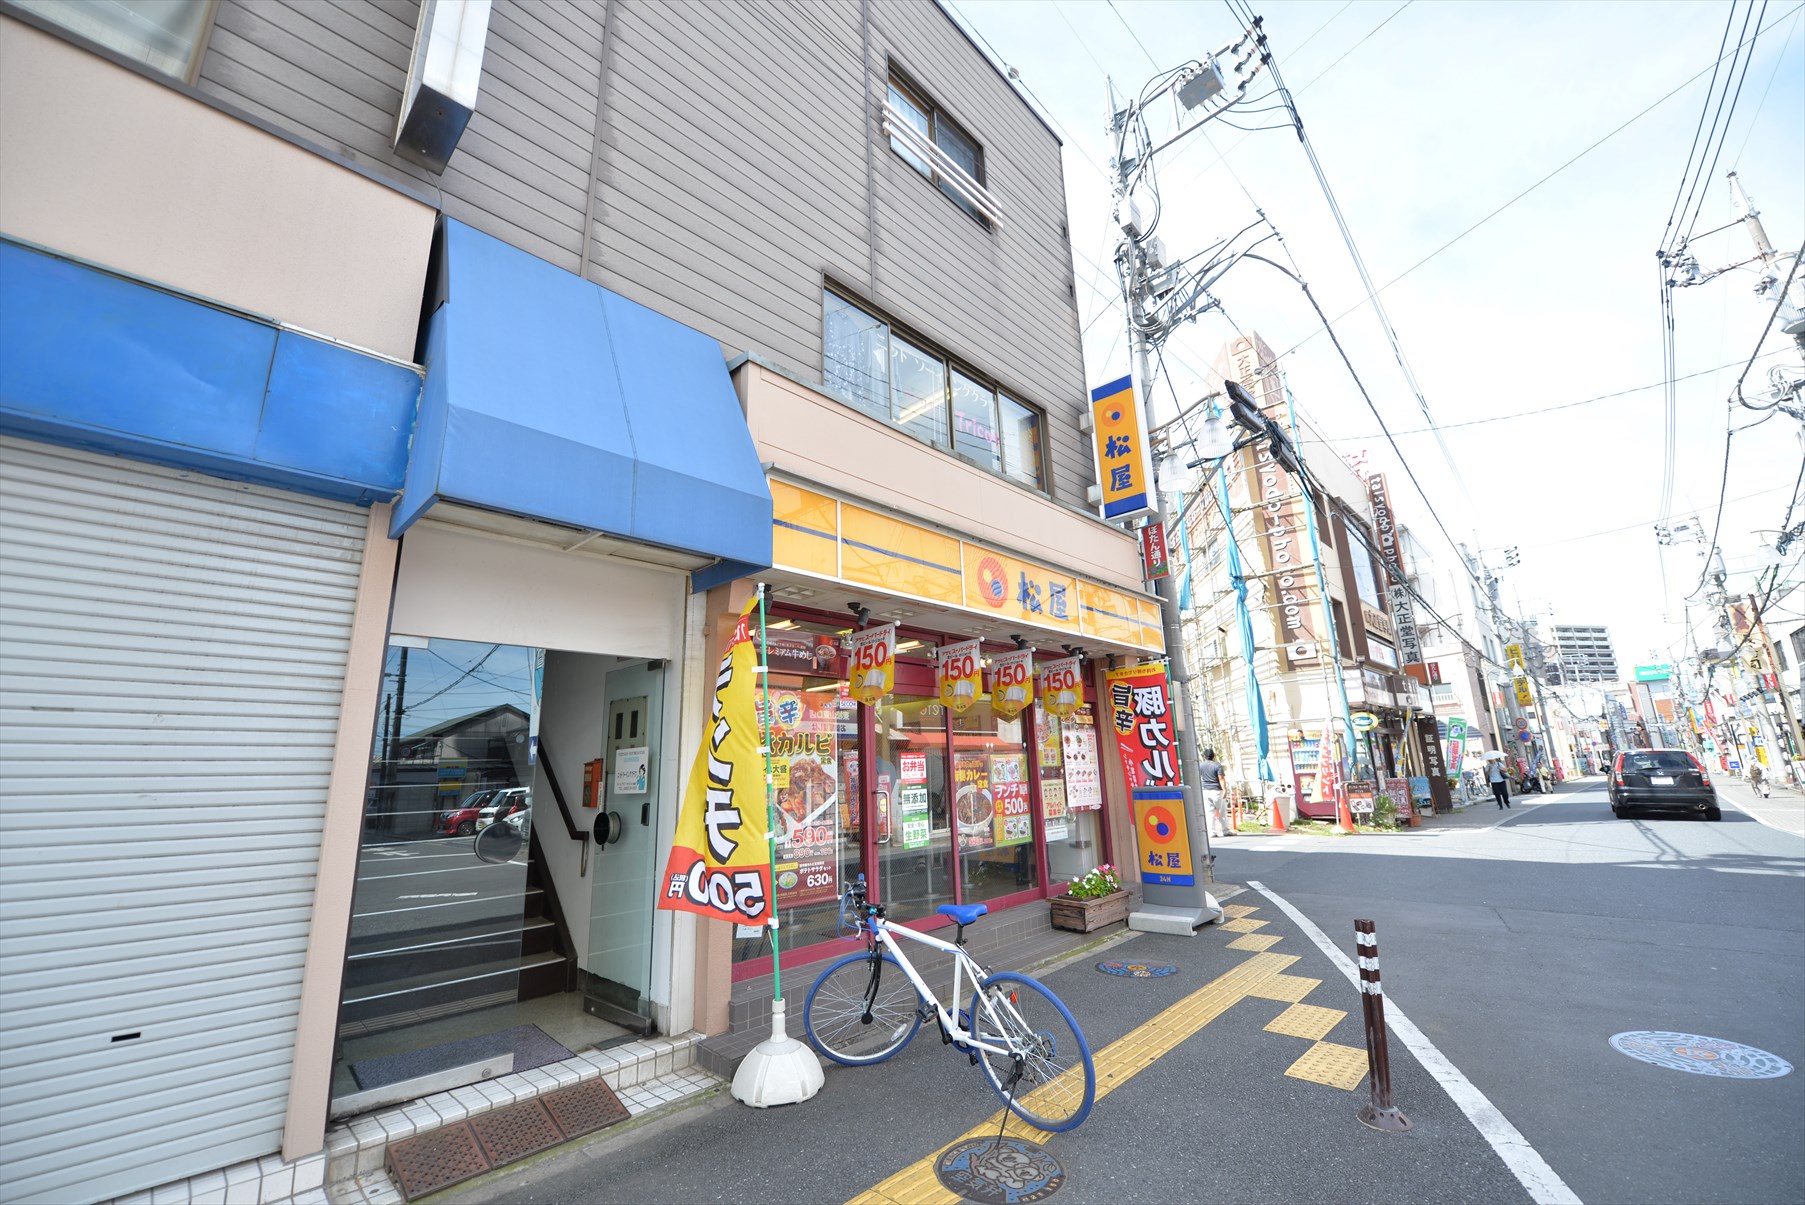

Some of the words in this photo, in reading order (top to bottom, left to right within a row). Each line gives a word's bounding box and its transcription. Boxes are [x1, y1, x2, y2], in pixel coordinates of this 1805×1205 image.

[954, 411, 999, 447] Tricot
[1105, 435, 1132, 492] 松屋
[1148, 525, 1161, 567] ぼたん通り
[1017, 571, 1069, 621] 松屋
[854, 641, 892, 671] 150円
[942, 655, 979, 682] 150円
[994, 663, 1031, 688] 150円
[1043, 669, 1080, 692] 150円
[902, 760, 925, 772] お弁当
[1424, 734, 1441, 777] 証明写真
[903, 793, 927, 805] 無添加
[905, 828, 928, 841] 生野菜
[1148, 851, 1182, 868] 松屋
[807, 873, 833, 887] 630円
